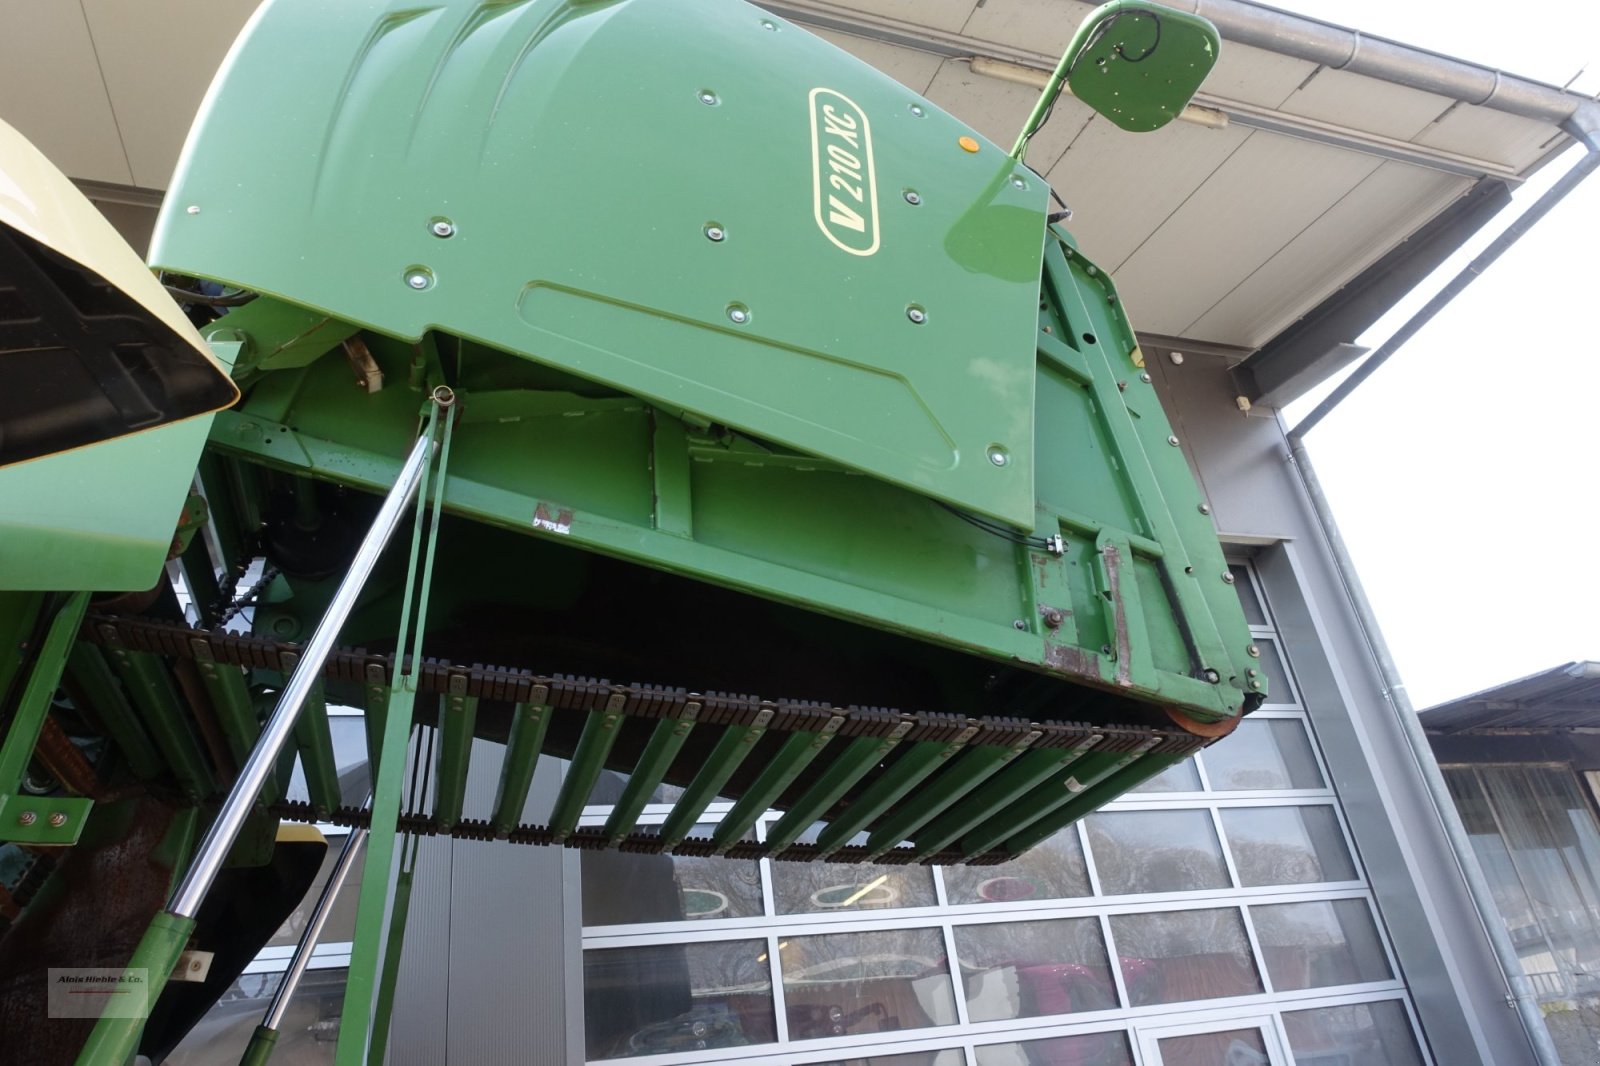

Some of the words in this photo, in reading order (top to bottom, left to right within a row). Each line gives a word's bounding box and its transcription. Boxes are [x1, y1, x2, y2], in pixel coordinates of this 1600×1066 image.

[822, 104, 859, 149] XC
[827, 144, 864, 203] 210
[828, 194, 865, 233] V
